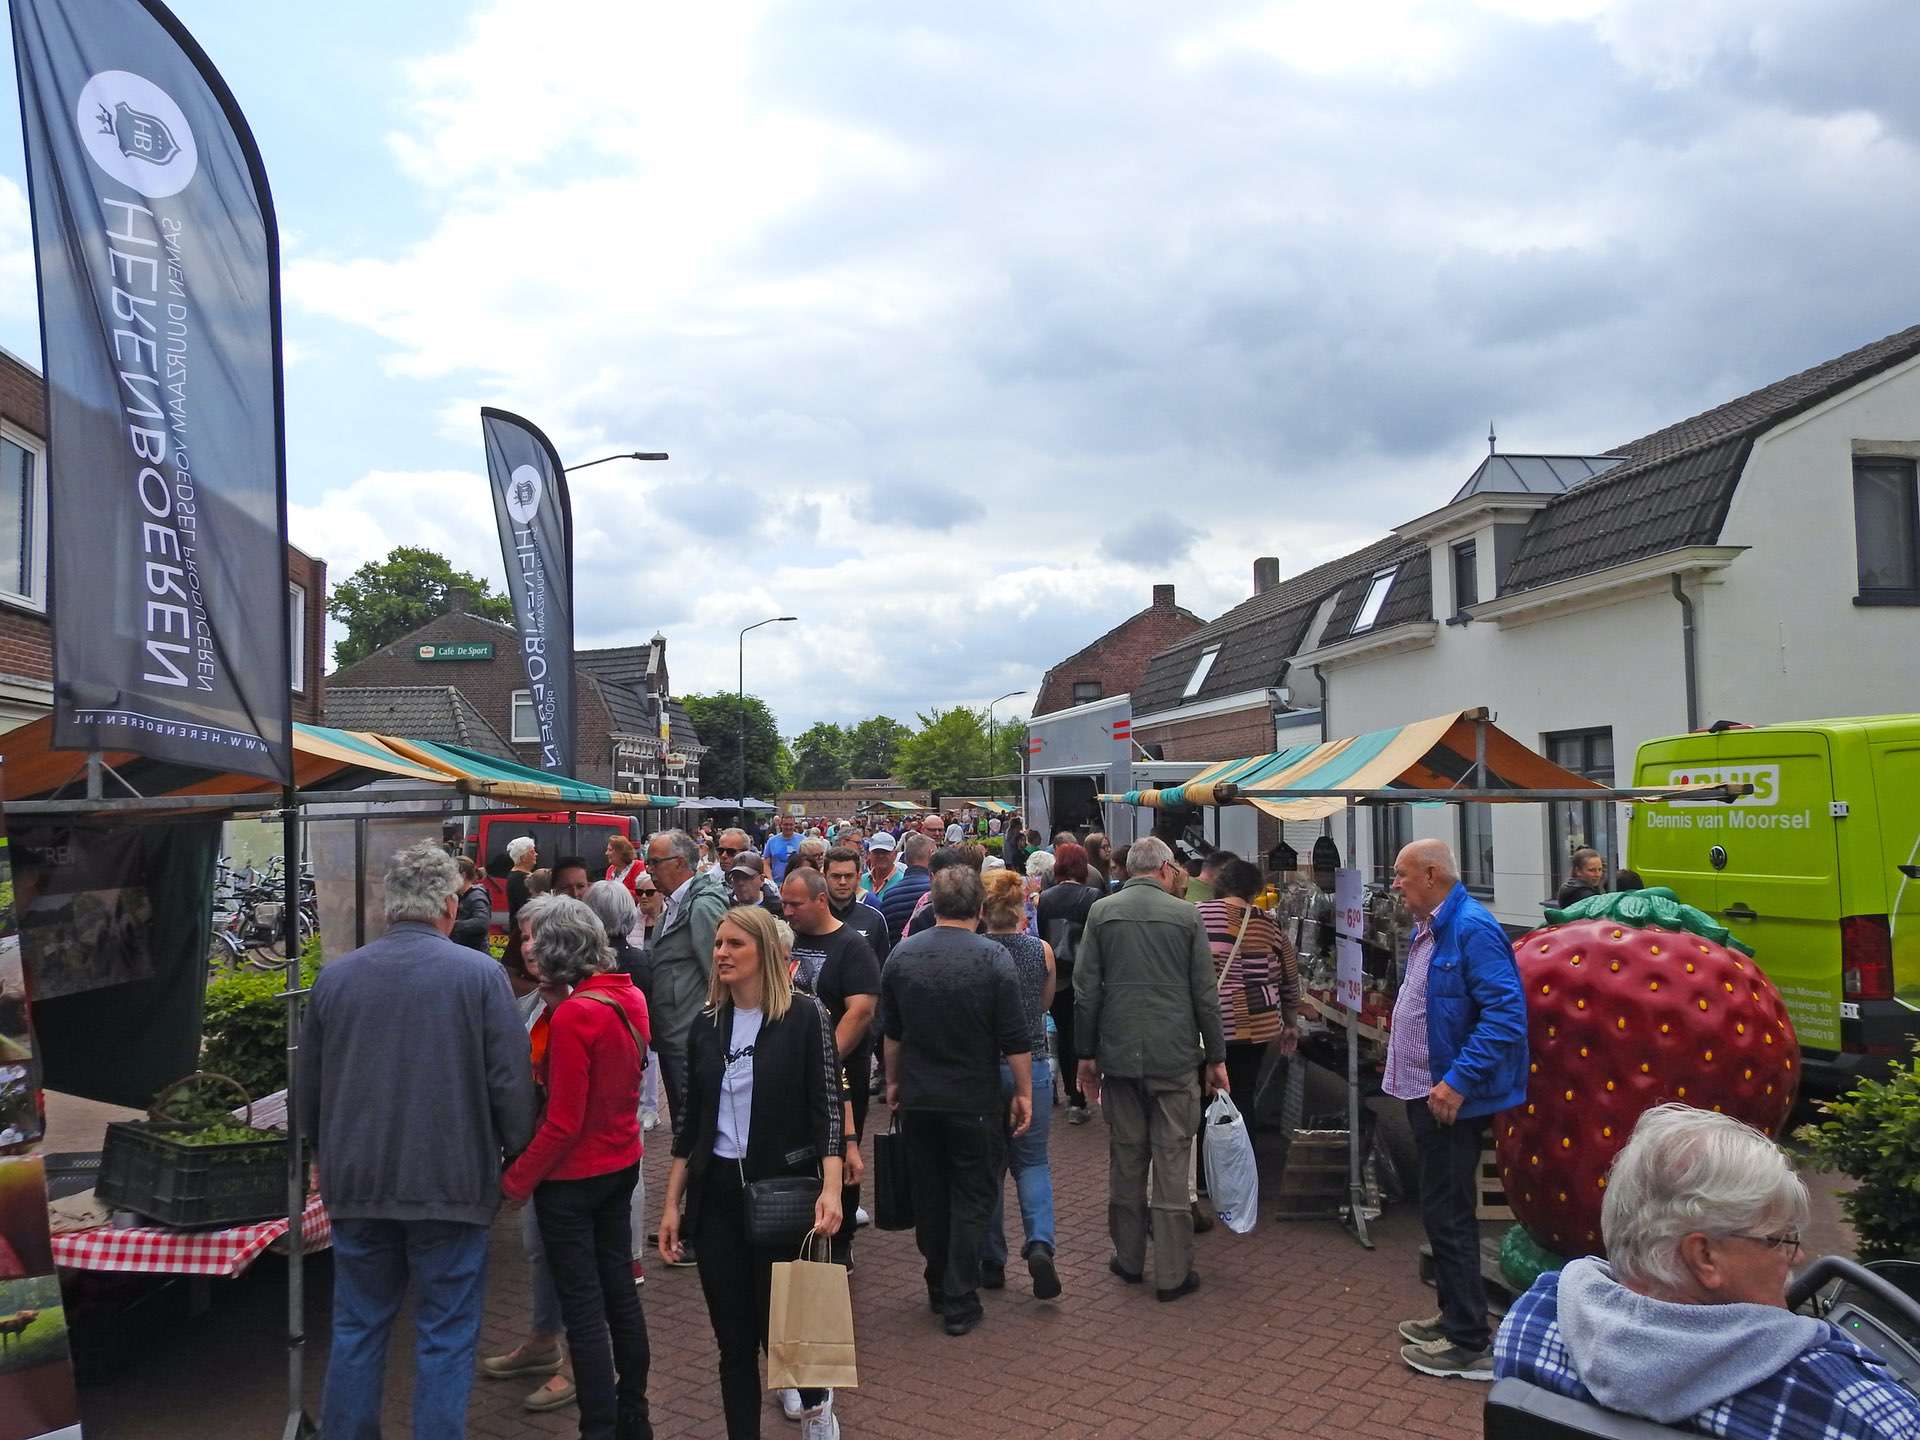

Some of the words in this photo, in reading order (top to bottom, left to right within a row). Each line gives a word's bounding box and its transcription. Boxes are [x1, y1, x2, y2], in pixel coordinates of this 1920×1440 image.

[438, 646, 455, 656] Café
[457, 647, 467, 655] De
[468, 646, 488, 657] Sport
[1647, 811, 1692, 829] Dennis
[1696, 814, 1723, 829] van
[1728, 809, 1810, 829] Moorsel
